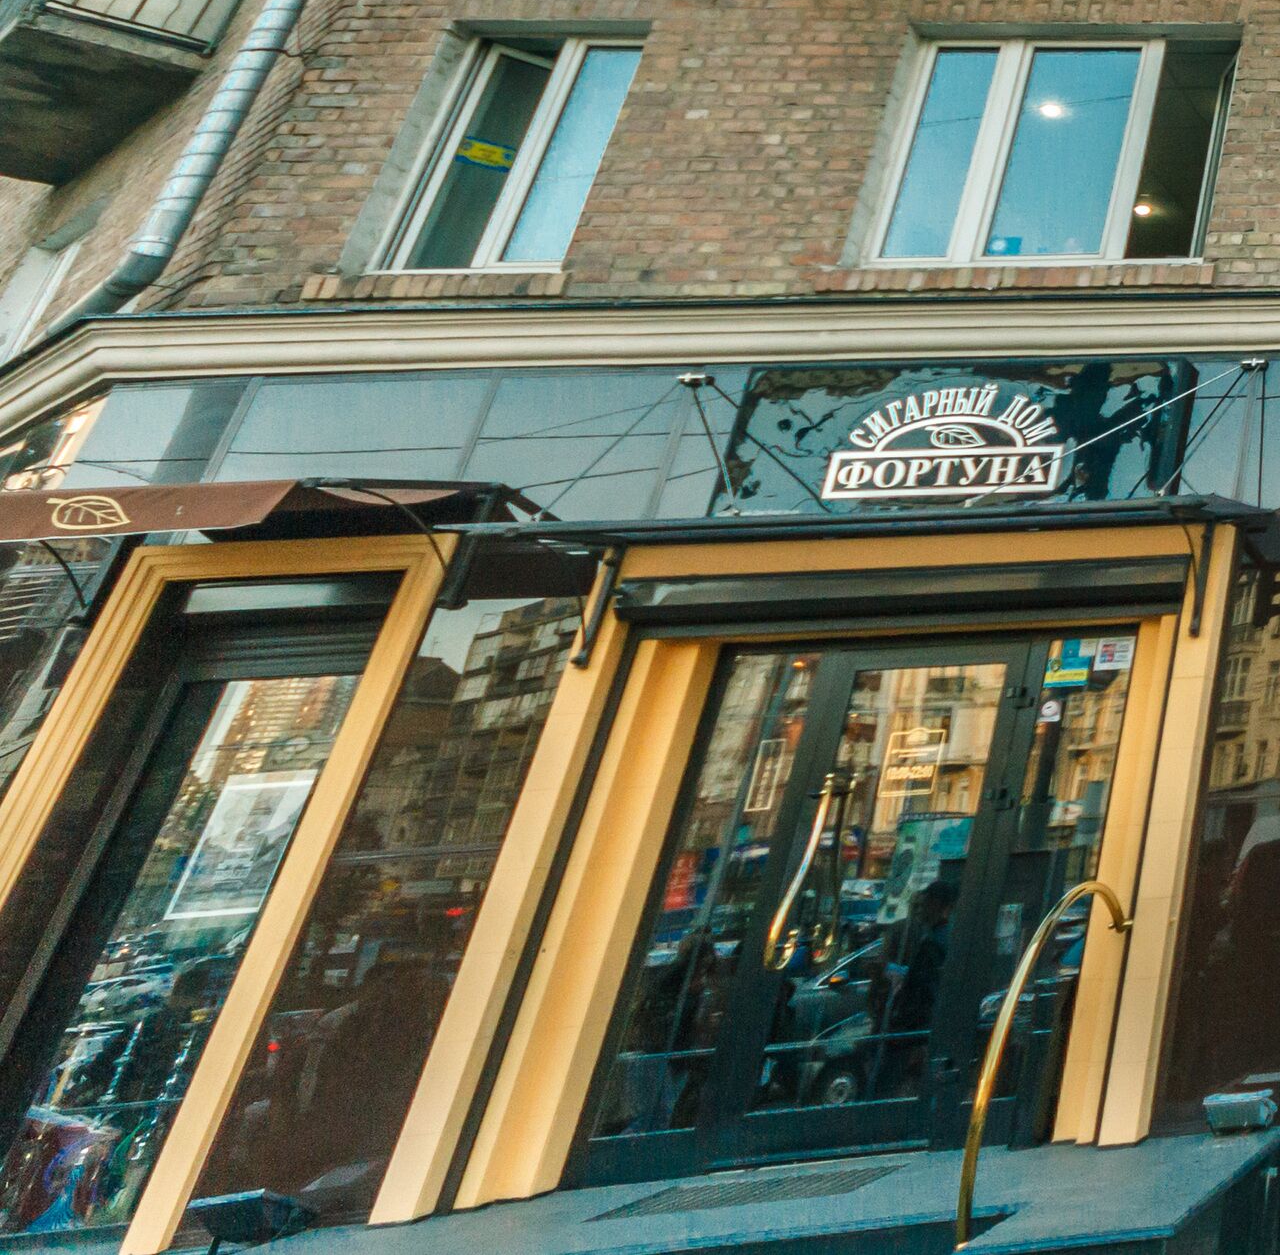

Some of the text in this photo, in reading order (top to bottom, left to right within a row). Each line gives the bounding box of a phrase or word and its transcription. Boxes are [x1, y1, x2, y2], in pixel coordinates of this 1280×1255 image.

[850, 384, 1058, 448] СИГАРНЫЙ ДОМ
[837, 455, 1049, 490] ФОРТУНА
